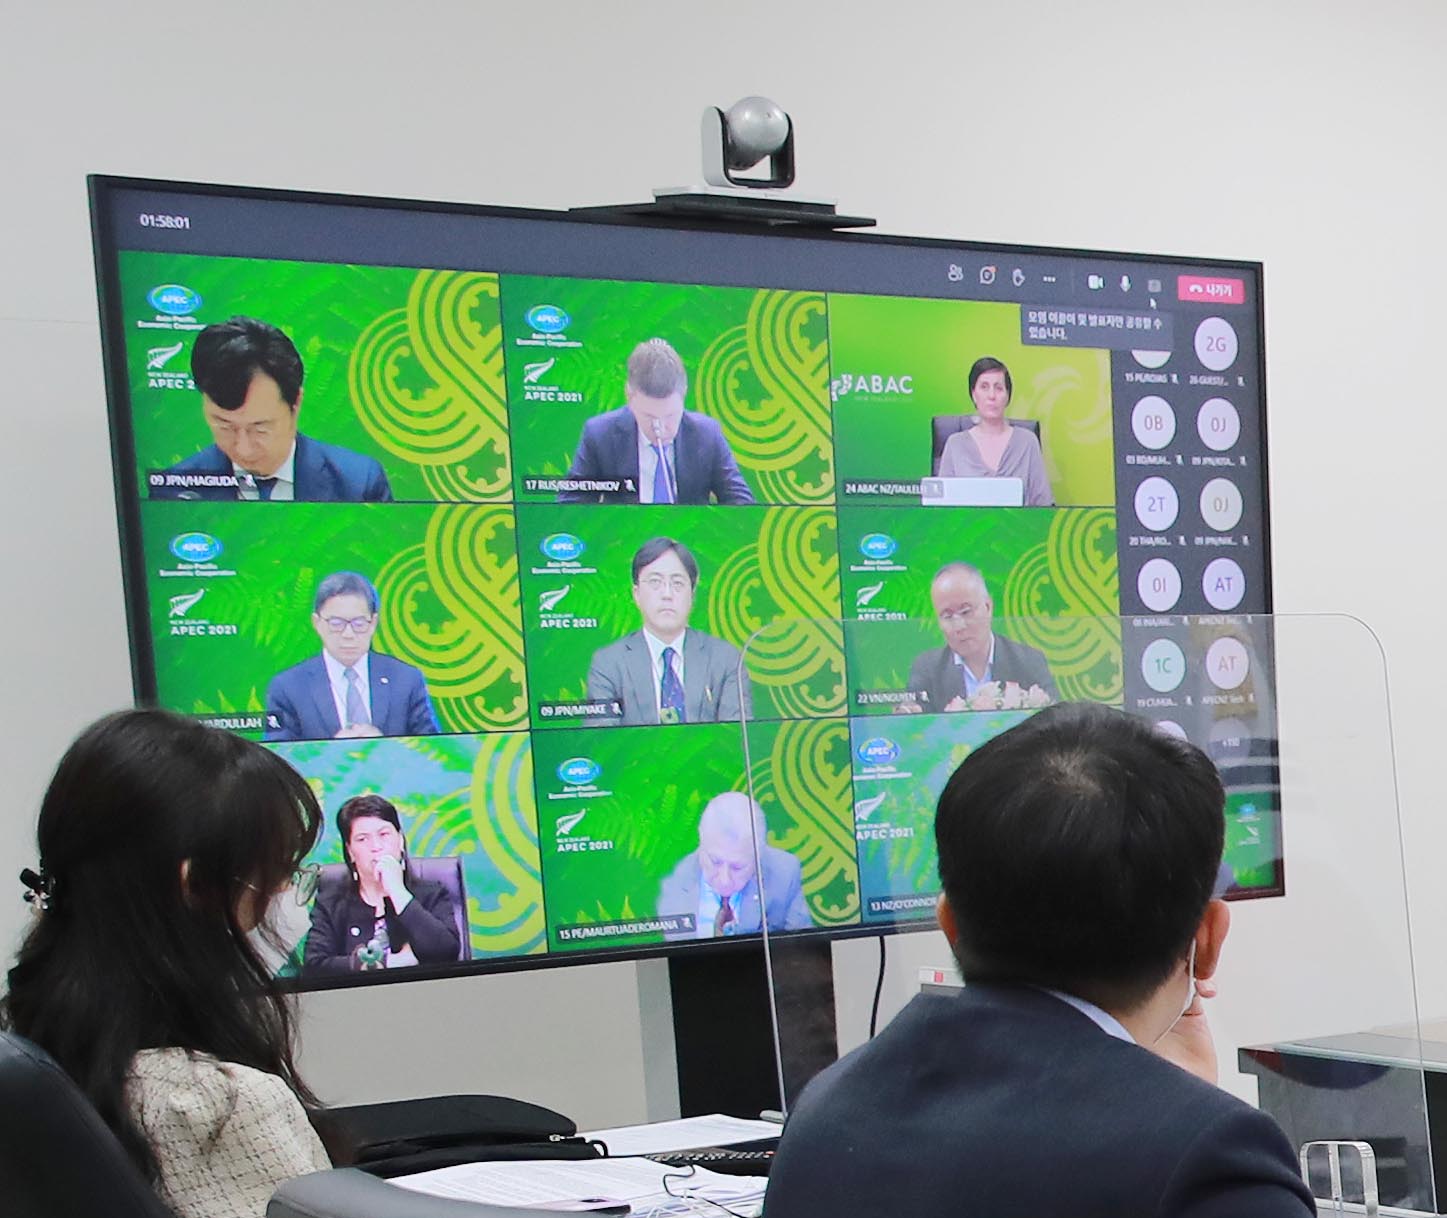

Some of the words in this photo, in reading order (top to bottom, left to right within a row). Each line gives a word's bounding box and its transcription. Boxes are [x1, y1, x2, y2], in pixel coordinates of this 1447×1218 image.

[139, 213, 191, 230] 01:58:01
[1206, 283, 1233, 298] 나가기
[148, 379, 185, 389] APEC
[854, 375, 913, 394] ABAC
[524, 391, 556, 402] APEC
[557, 392, 582, 403] 2021
[150, 474, 165, 486] 09
[525, 480, 537, 490] 17
[1214, 577, 1233, 593] AT
[540, 619, 570, 629] APEC
[572, 618, 597, 629] 2021
[170, 625, 205, 636] APEC
[208, 625, 238, 636] 2021
[1218, 655, 1237, 672] AT
[856, 829, 888, 841] APEC
[890, 827, 914, 839] 2021
[557, 842, 587, 853] APEC
[588, 840, 614, 851] 2021
[560, 930, 571, 940] 15
